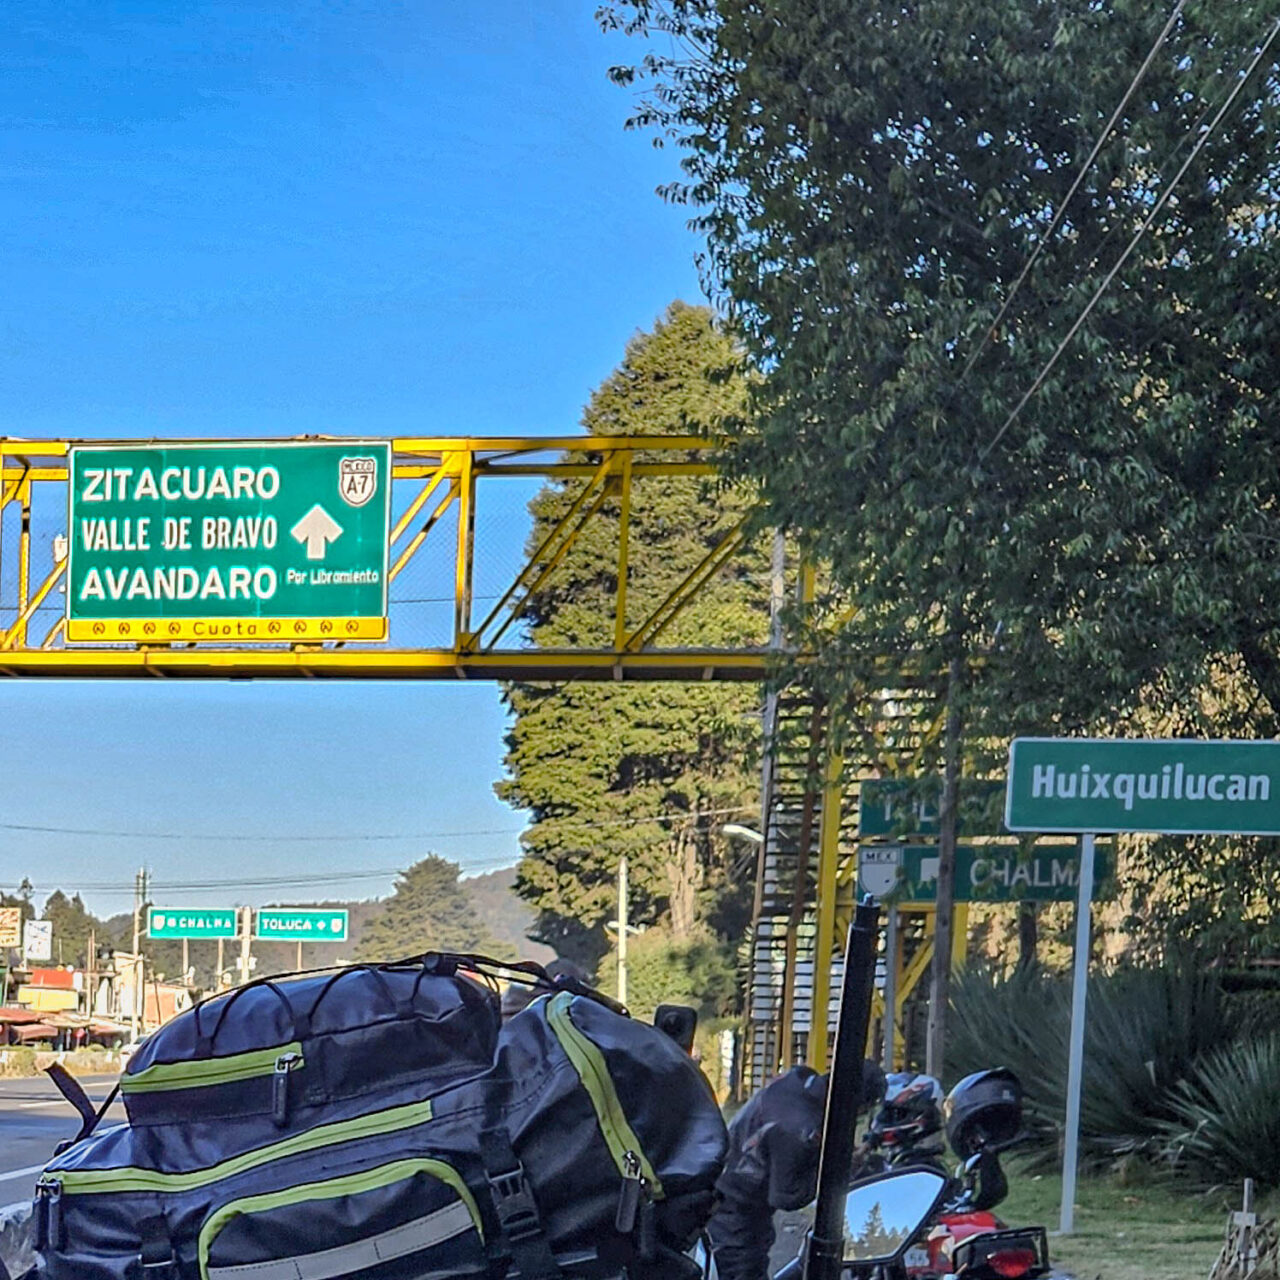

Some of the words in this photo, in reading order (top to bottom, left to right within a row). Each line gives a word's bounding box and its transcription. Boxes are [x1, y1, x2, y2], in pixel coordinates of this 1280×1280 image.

[81, 466, 281, 502] ZITACUARO
[347, 475, 368, 495] A-7
[81, 517, 151, 551] VALLE
[164, 517, 192, 550] DE
[201, 516, 278, 549] BRAVO
[80, 566, 277, 600] AVANDARO
[286, 569, 308, 585] Por
[193, 621, 257, 636] Cuota
[1031, 762, 1271, 811] Huixquilucan
[262, 918, 312, 931] TOLUCA
